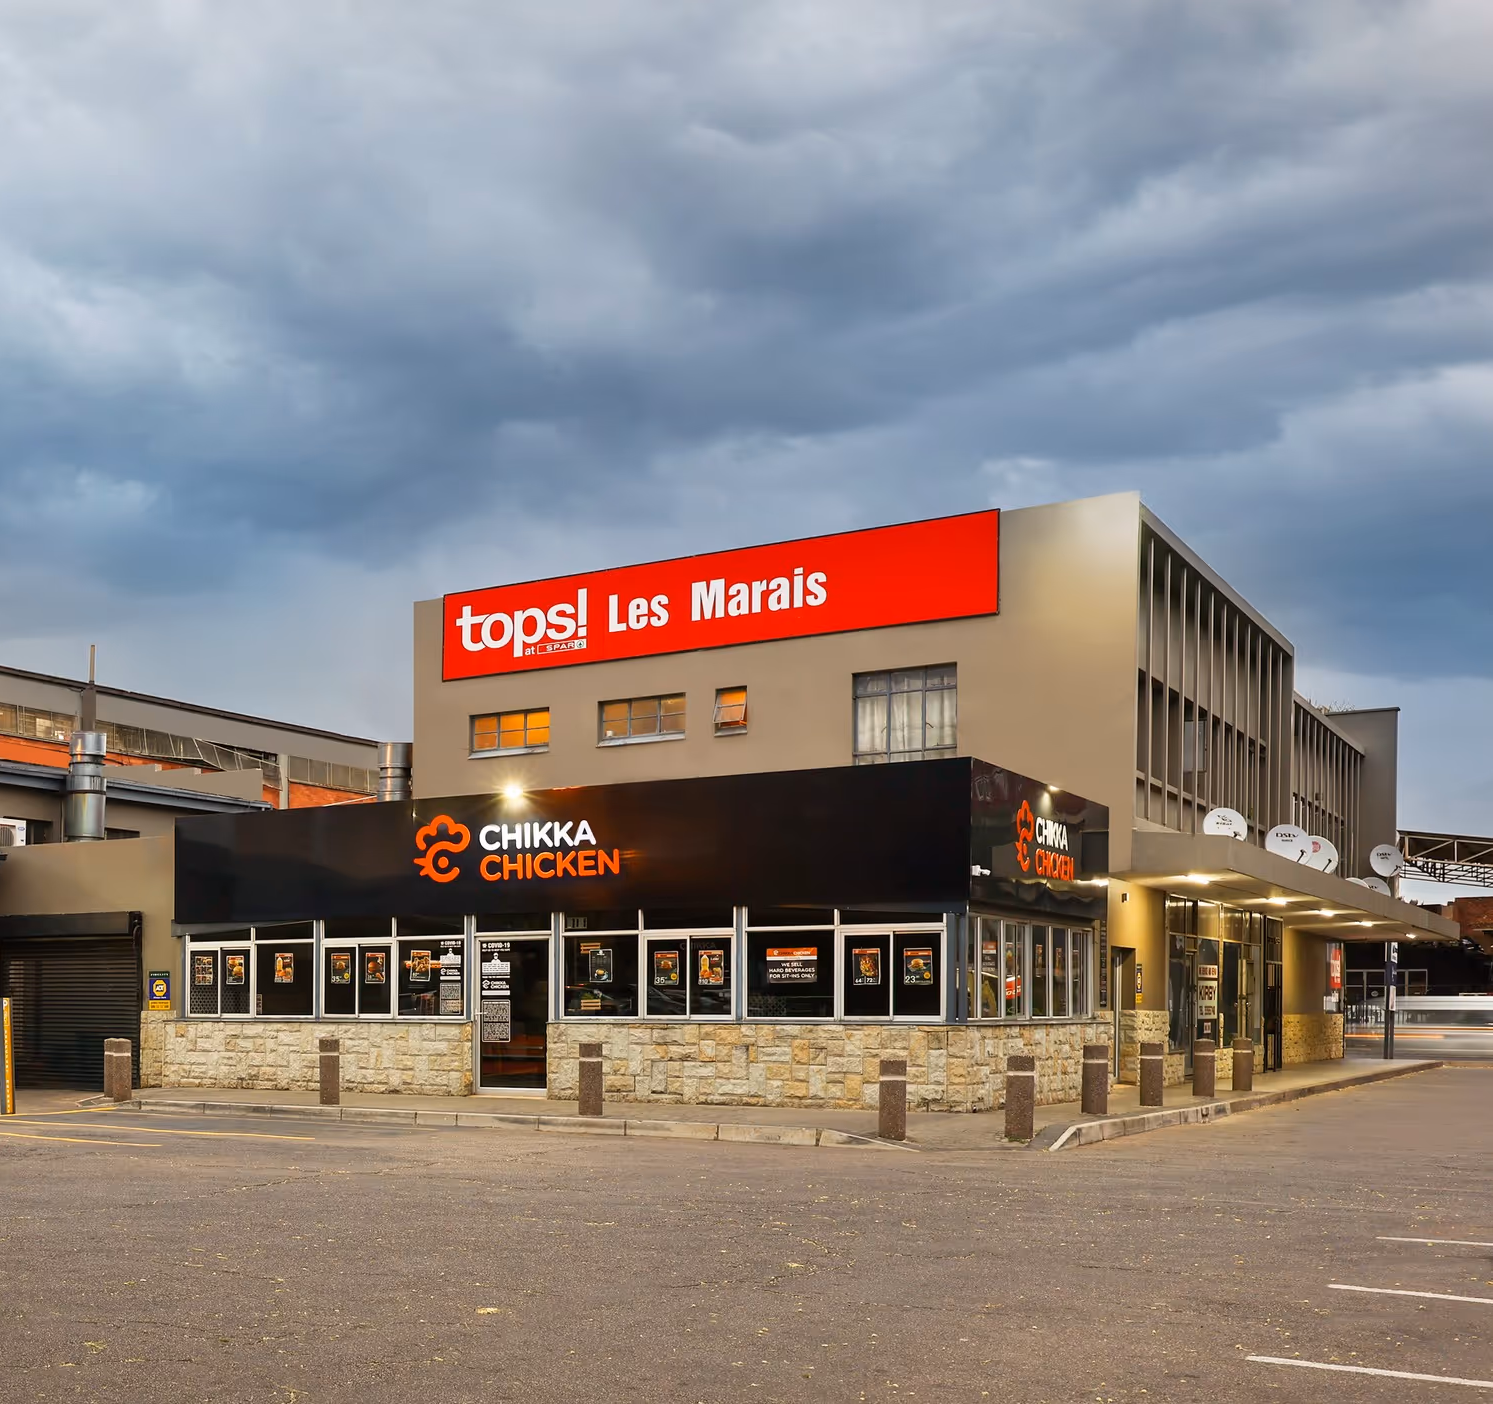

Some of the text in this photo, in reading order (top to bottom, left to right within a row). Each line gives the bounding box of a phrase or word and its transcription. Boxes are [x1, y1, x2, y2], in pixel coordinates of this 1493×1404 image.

[608, 566, 827, 633] Les Marais
[456, 588, 588, 658] tops!
[525, 645, 535, 656] at
[545, 642, 575, 652] SPAR
[479, 820, 597, 851] CHIKKA
[1035, 816, 1069, 852] CHIKKA
[480, 849, 620, 882] CHICKEN
[1035, 848, 1075, 882] CHICKEN
[655, 976, 665, 984] 35
[1199, 985, 1216, 1001] KIRBY
